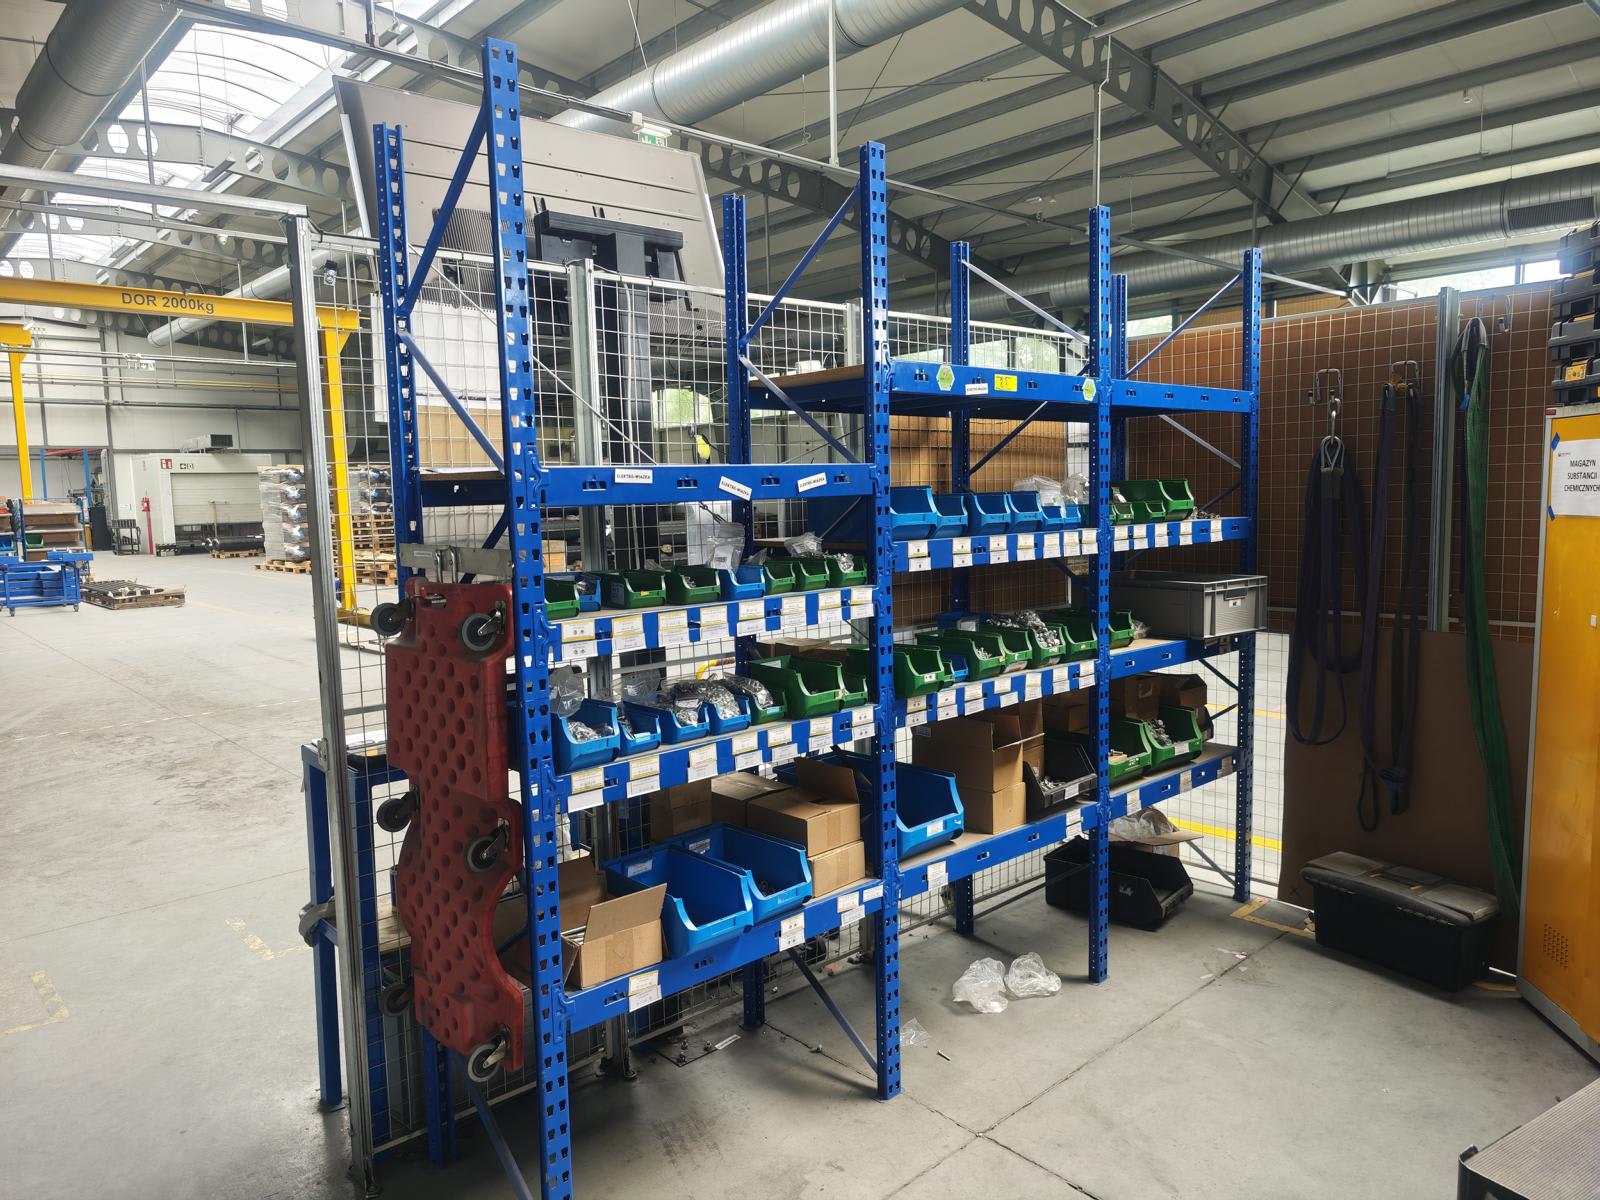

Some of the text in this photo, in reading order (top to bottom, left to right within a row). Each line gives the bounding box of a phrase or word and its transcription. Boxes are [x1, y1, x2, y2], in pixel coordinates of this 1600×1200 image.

[121, 292, 214, 314] DOR 2000kg
[1569, 459, 1596, 467] MAGAZYN
